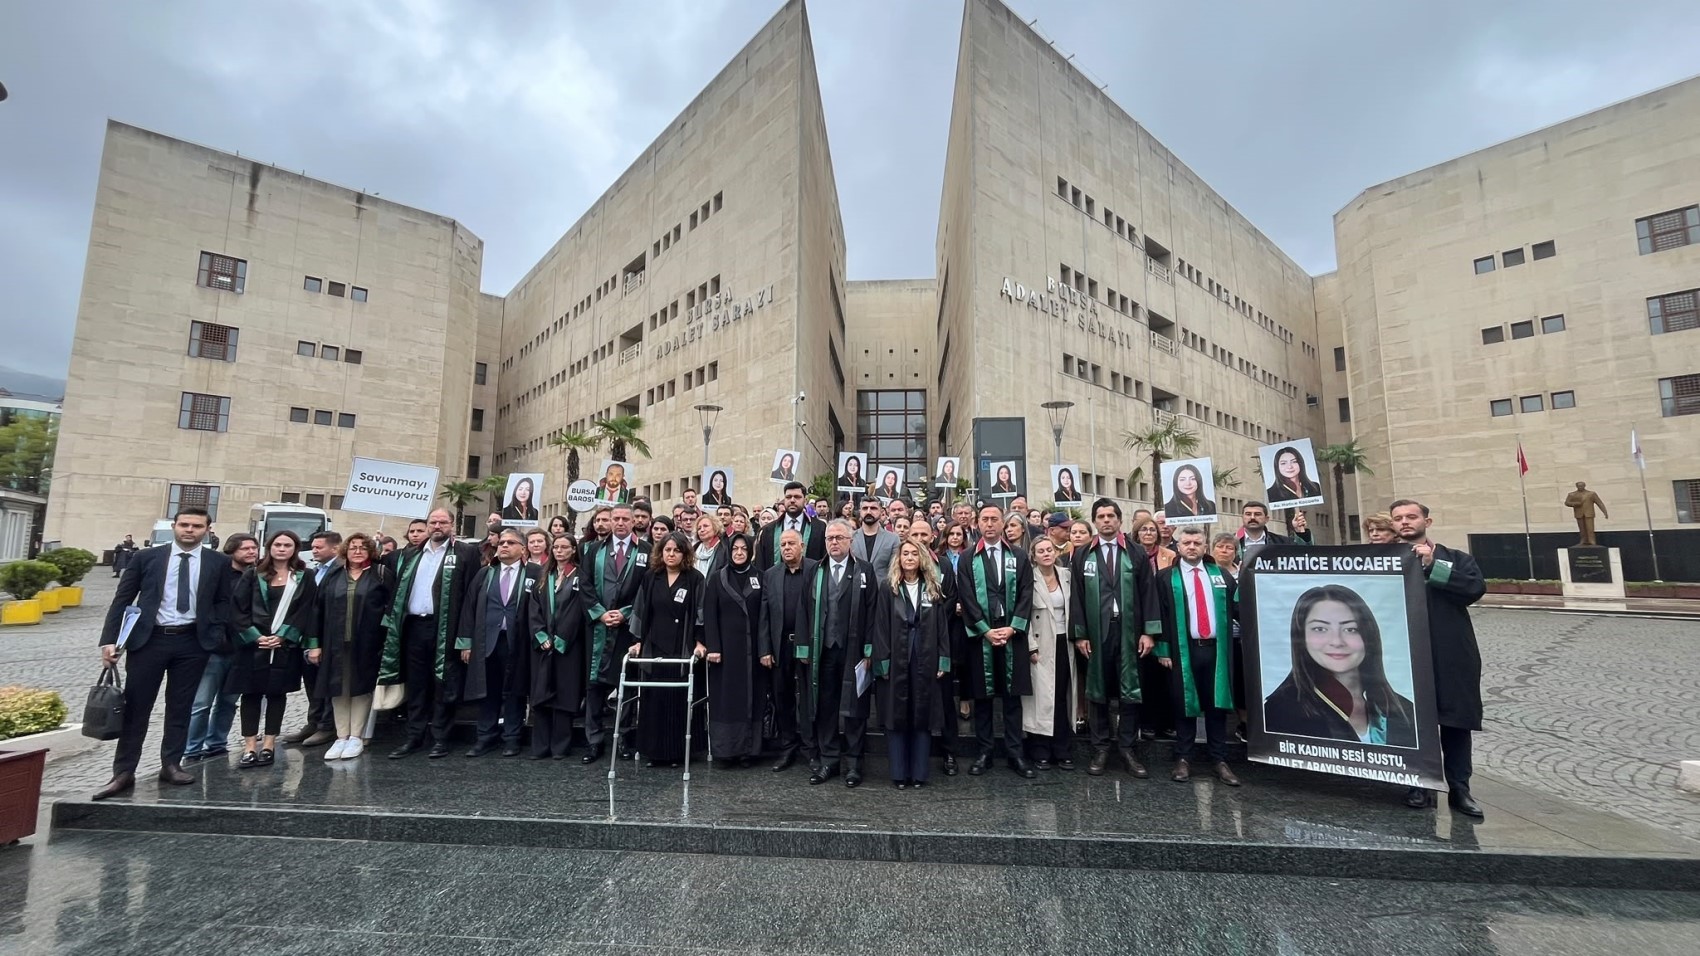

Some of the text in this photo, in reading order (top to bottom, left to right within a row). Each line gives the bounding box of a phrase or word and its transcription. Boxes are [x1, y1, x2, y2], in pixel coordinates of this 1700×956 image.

[686, 286, 733, 325] BURSA
[1046, 275, 1098, 317] BURSA
[1000, 277, 1131, 349] ADALET SARAYI
[656, 322, 704, 360] ADALET
[351, 484, 429, 501] Savunuyoruz
[359, 472, 428, 490] Savunmayı
[571, 487, 595, 495] BURSA
[1254, 553, 1403, 571] Av. HATİCE KOCAEFE
[1279, 739, 1407, 770] BİR KADININ SESİ SUSTU,
